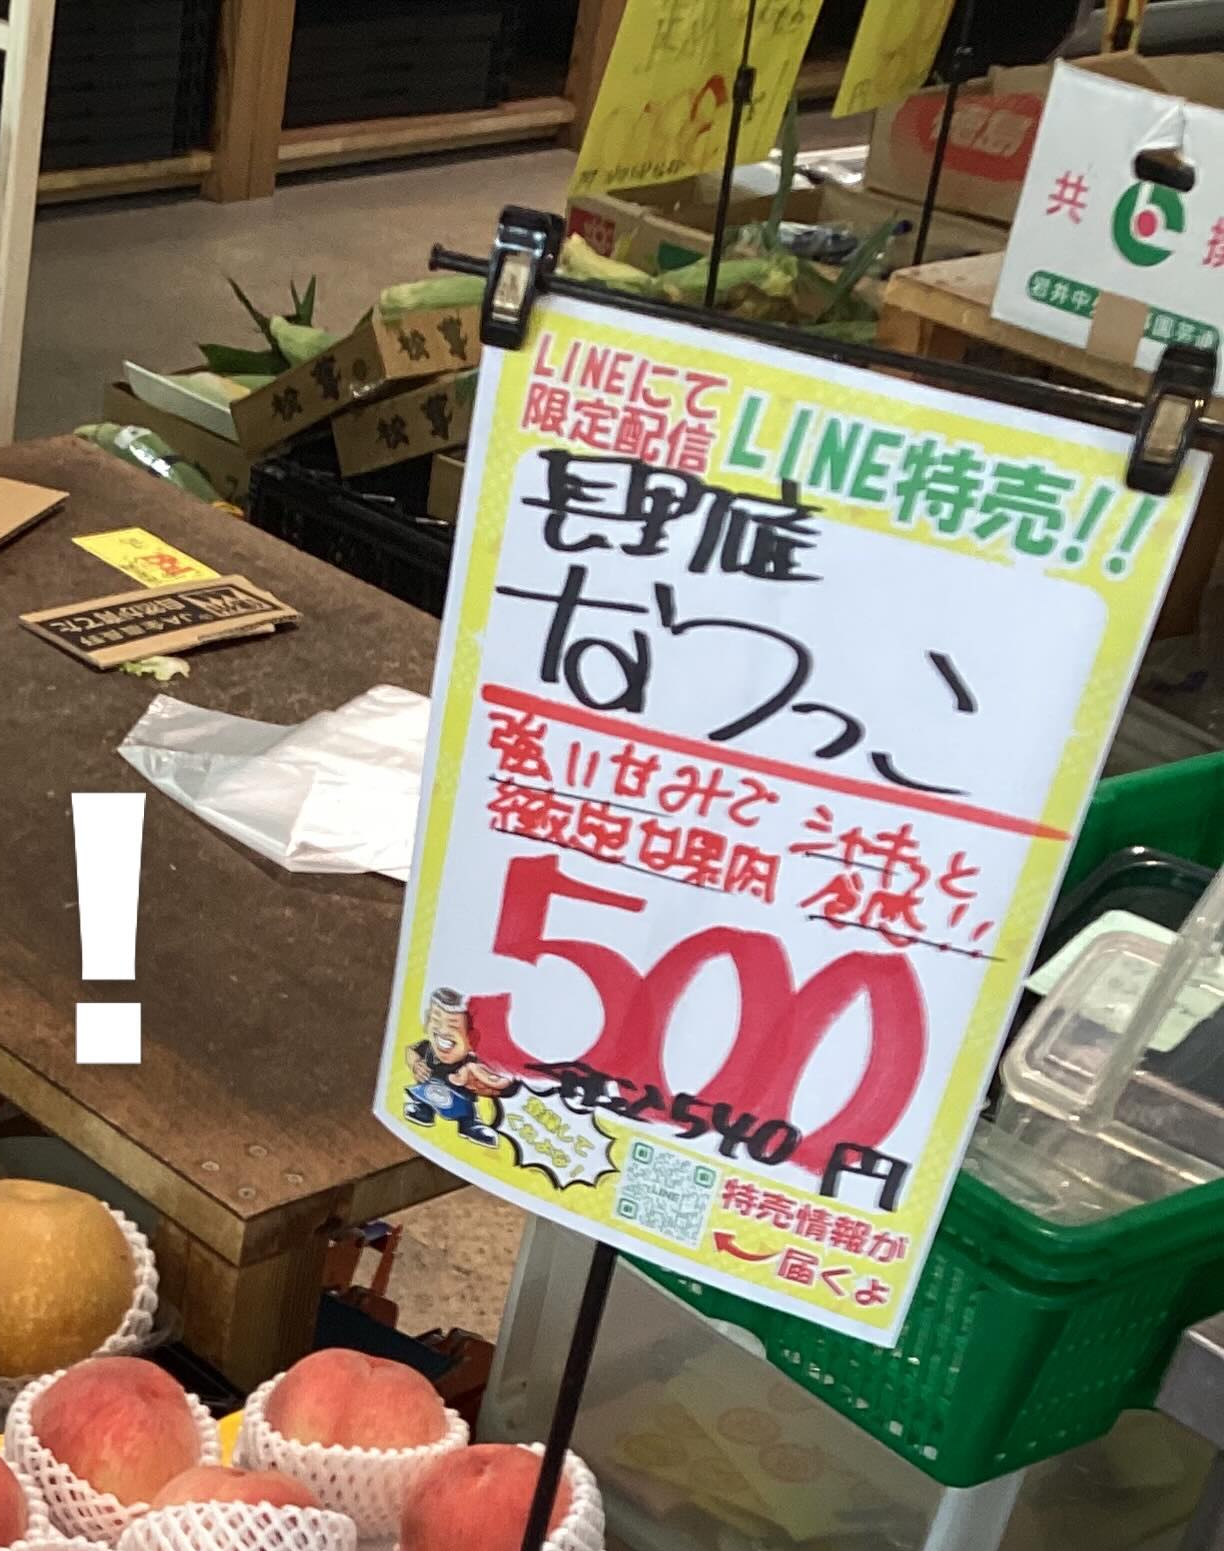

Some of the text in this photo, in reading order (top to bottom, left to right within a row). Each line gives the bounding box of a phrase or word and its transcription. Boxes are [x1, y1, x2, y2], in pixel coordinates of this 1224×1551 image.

[1046, 170, 1089, 224] 共
[533, 333, 729, 419] LINEにて
[521, 382, 717, 474] 限定配信
[520, 448, 825, 582] 長野産
[496, 563, 979, 797] なつっこ
[487, 711, 781, 827] 強い甘みで
[467, 854, 931, 1213] 500 円
[720, 1177, 911, 1264] 特売情報が
[777, 1247, 891, 1307] 届くよ
